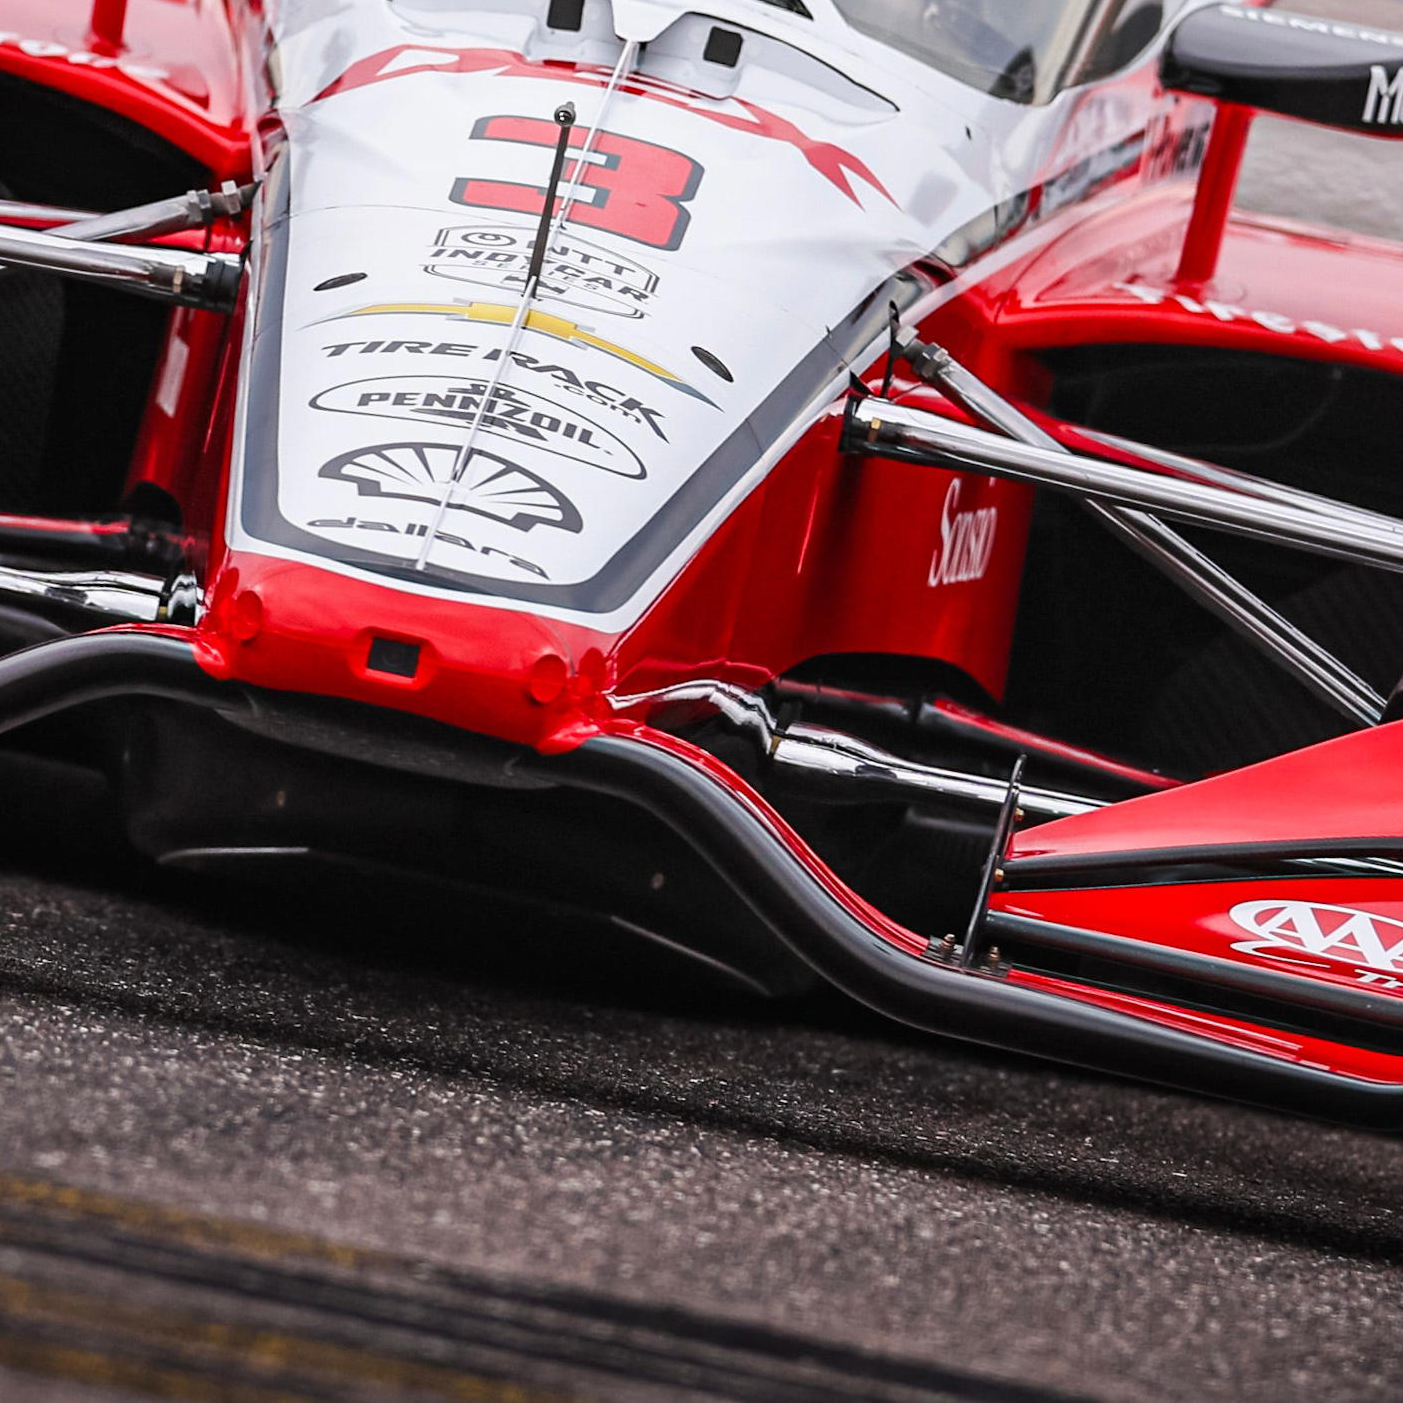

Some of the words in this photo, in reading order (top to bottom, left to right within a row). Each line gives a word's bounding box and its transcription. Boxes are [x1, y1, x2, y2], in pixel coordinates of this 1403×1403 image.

[449, 114, 705, 252] 3
[474, 259, 598, 291] SEIES
[356, 391, 602, 449] PENNZOIL
[306, 517, 551, 580] dallara
